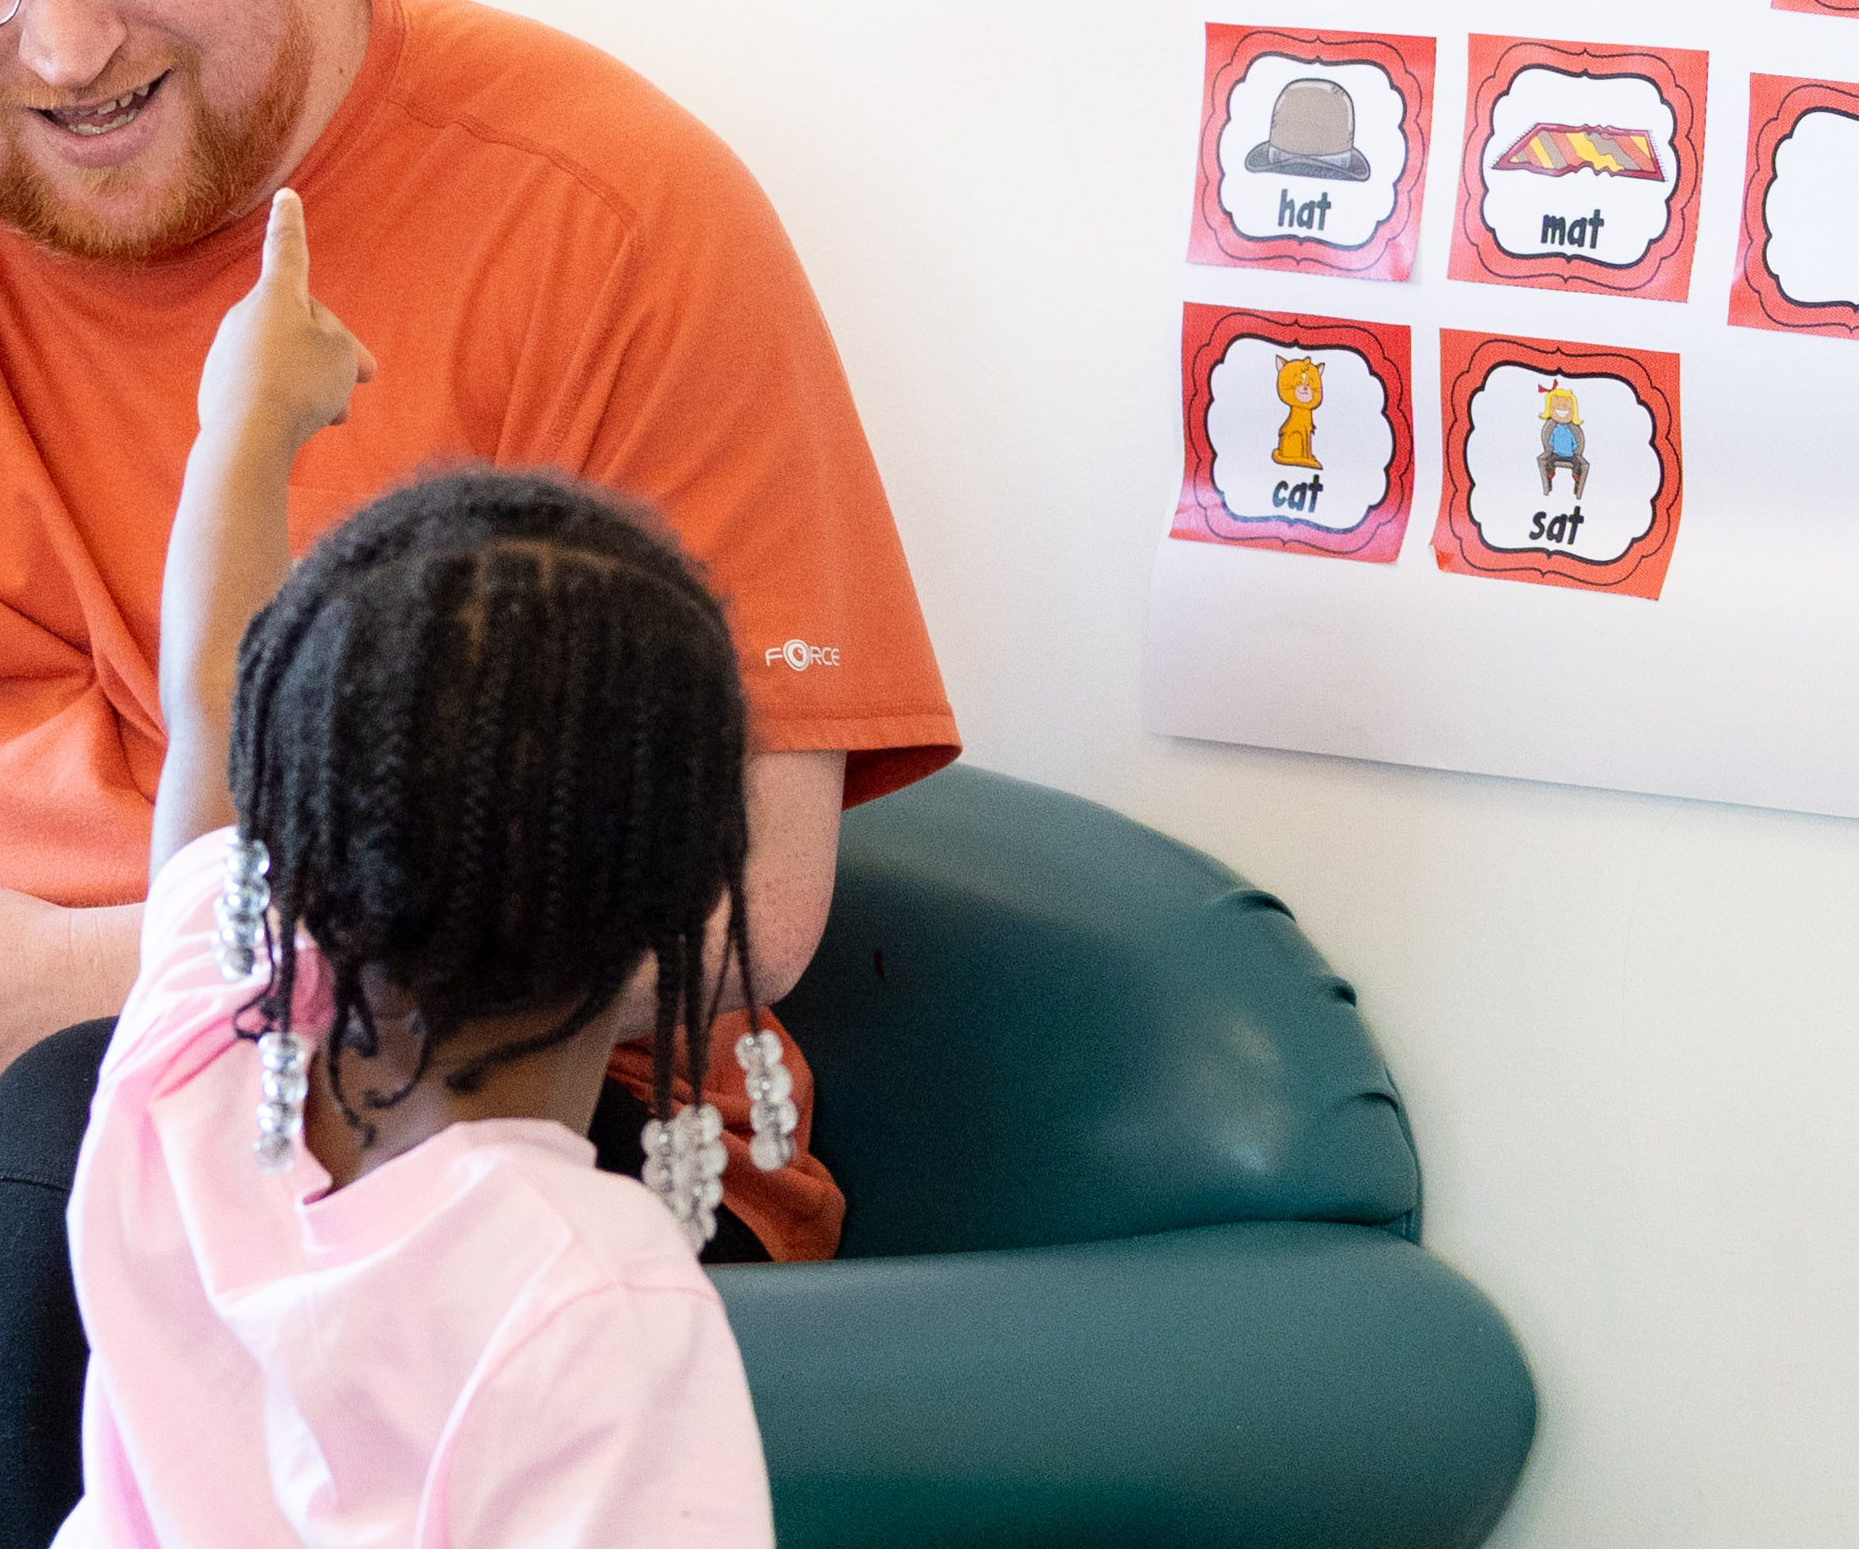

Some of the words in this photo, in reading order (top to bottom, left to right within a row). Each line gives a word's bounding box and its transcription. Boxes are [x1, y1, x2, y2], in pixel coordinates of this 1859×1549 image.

[1277, 188, 1331, 231] hat
[1540, 209, 1604, 249] mat
[1272, 474, 1323, 513] cat
[1529, 506, 1584, 544] sat
[765, 639, 840, 672] FORCE
